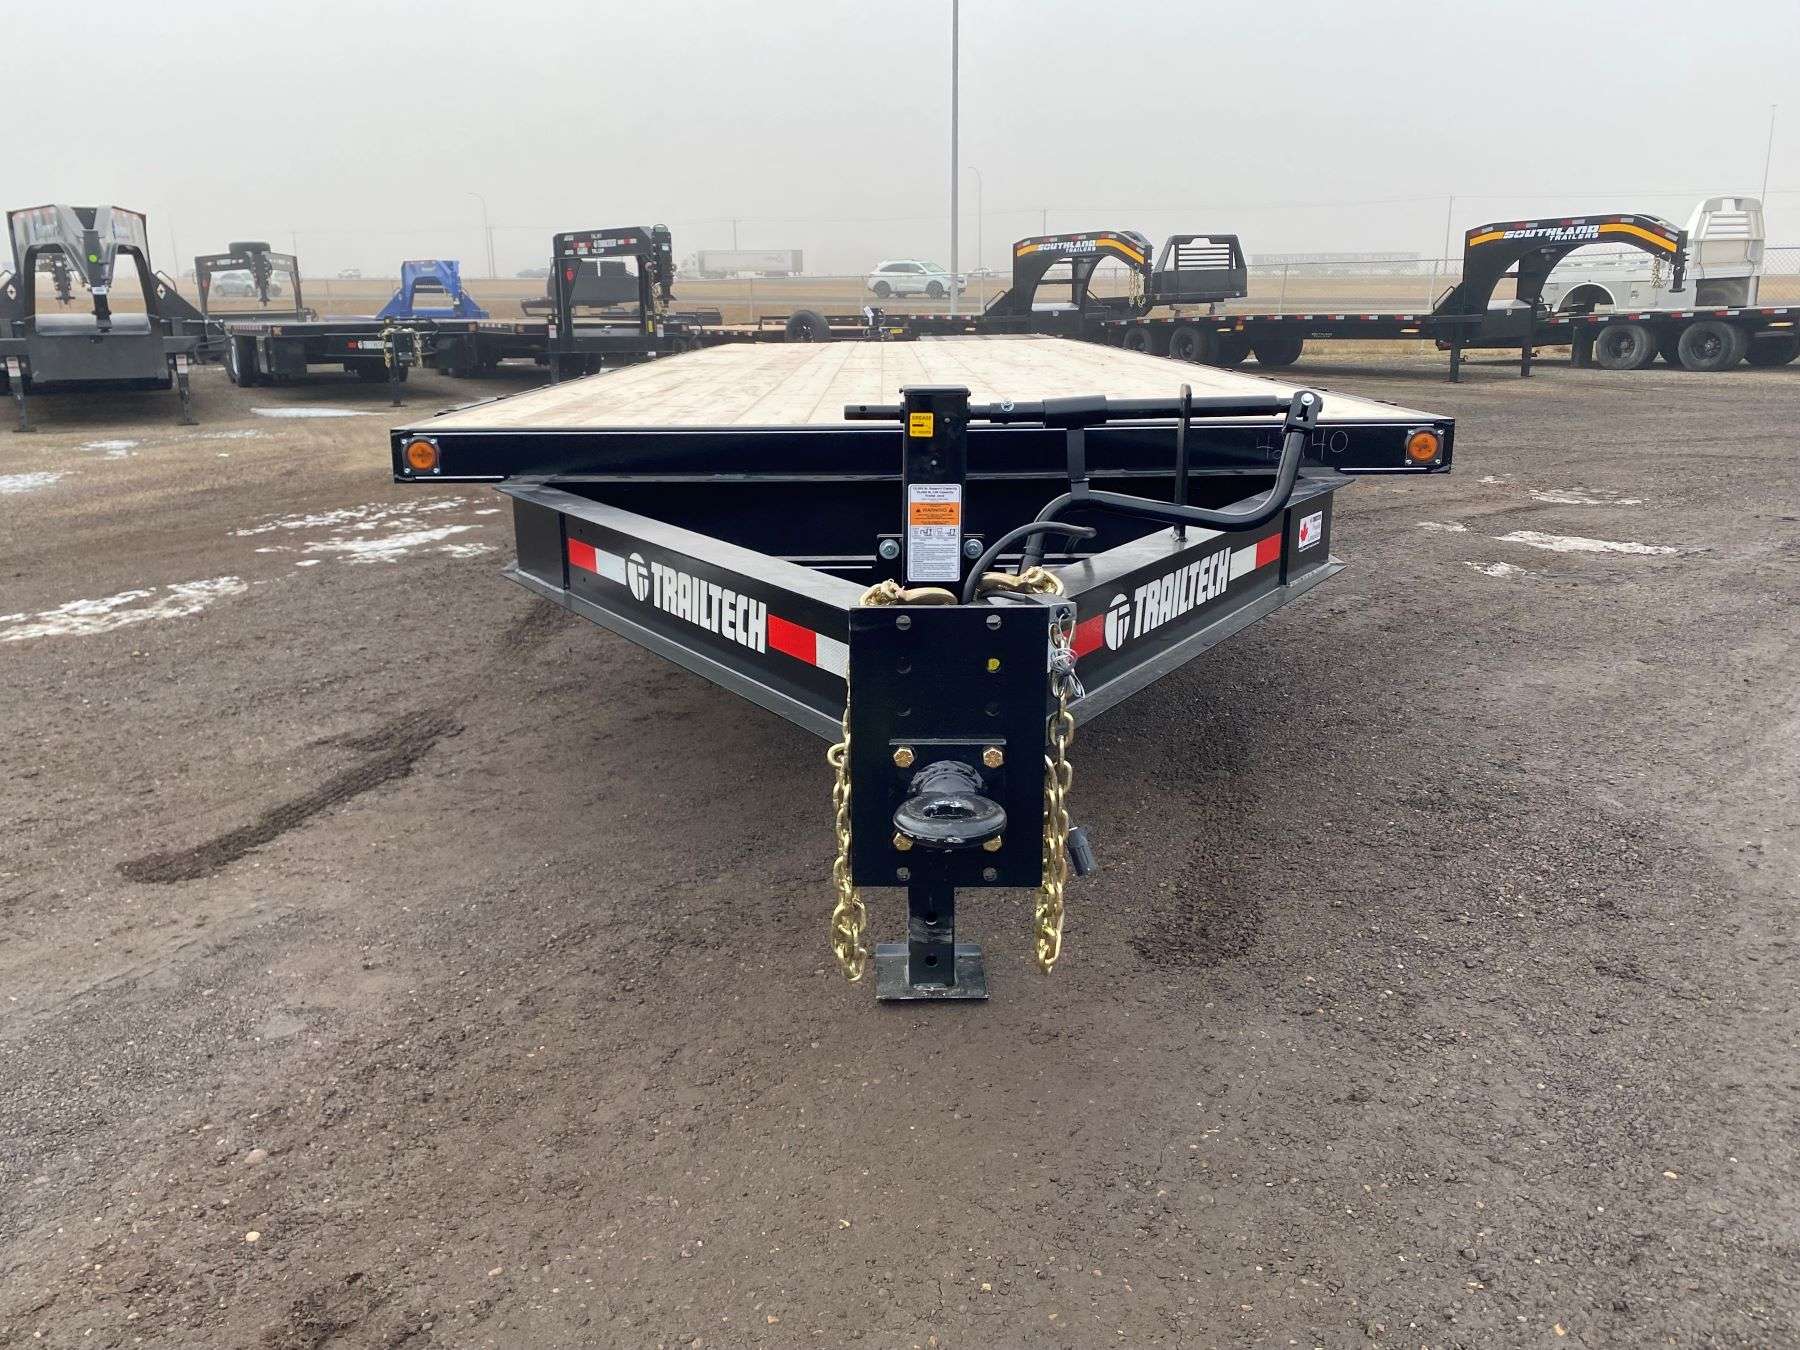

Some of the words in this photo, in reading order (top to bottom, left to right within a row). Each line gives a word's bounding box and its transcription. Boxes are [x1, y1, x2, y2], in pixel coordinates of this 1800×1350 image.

[1503, 224, 1601, 239] SOUTHLAND
[1549, 233, 1599, 241] TRAILERS
[1038, 239, 1097, 251] SOUTHLAND
[1133, 547, 1231, 638] TRAILTECH
[650, 561, 767, 654] TRAILTECH
